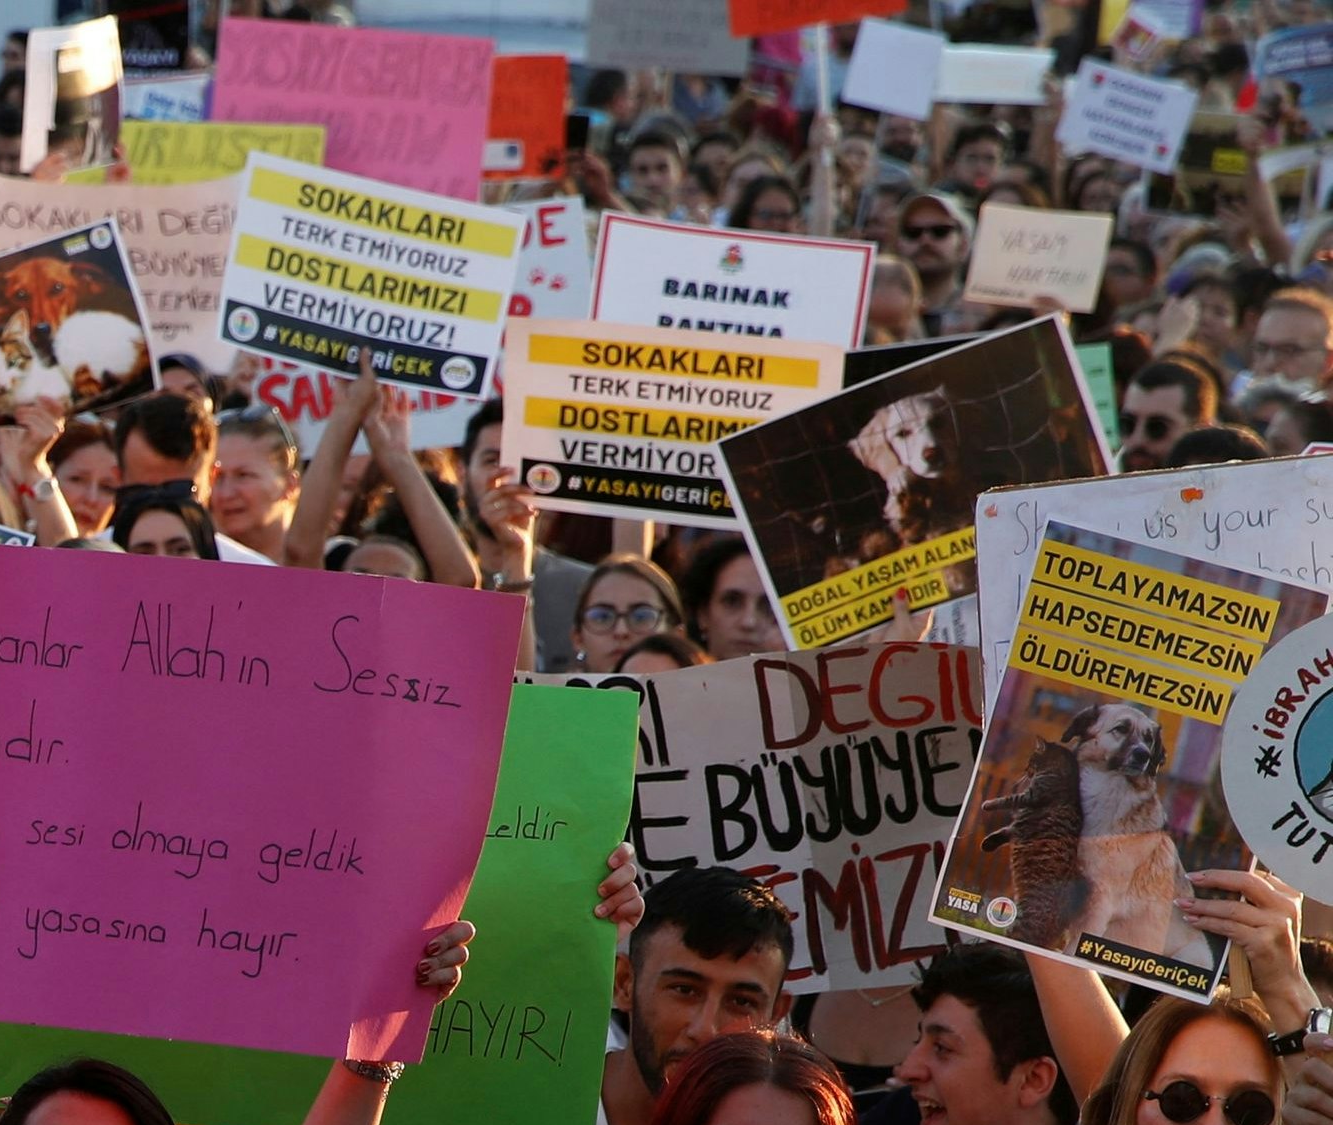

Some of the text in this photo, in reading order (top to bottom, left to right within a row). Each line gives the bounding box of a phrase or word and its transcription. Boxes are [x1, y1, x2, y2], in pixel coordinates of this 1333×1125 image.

[296, 183, 467, 245] SOKAKLARI
[282, 215, 470, 279] TERK ETMİYORUZ
[265, 247, 469, 316] DOSTLARIMIZI
[662, 277, 790, 310] BARINAK
[263, 282, 456, 349] VERMİYORUZ!
[264, 325, 433, 378] #YASAYIGRİÇEK
[582, 341, 765, 381] SOKAKLARI
[569, 373, 774, 412] TERK ETMİYORUZ
[559, 404, 746, 444] DOSTLARIM
[560, 439, 716, 477] VERMİYOR
[1144, 506, 1279, 552] us your
[786, 535, 976, 620] DOĞAL YAŞAM ALAN
[1043, 550, 1272, 634] TOPLAYAMAZSIN
[799, 609, 852, 645] ÖLÜM
[1028, 594, 1255, 677] HAPSEDEMEZSİN
[1018, 634, 1224, 716] ÖLDÜREMEZSİN
[485, 805, 569, 843] eldir
[704, 727, 959, 863] BÜYÜYE
[24, 817, 86, 847] sesi
[111, 802, 230, 881] olmaya
[259, 830, 365, 883] geldik
[946, 895, 980, 915] YASA
[22, 905, 167, 961] yasasına
[199, 908, 300, 980] hayır.
[1079, 937, 1210, 991] #YasayıGeriÇek
